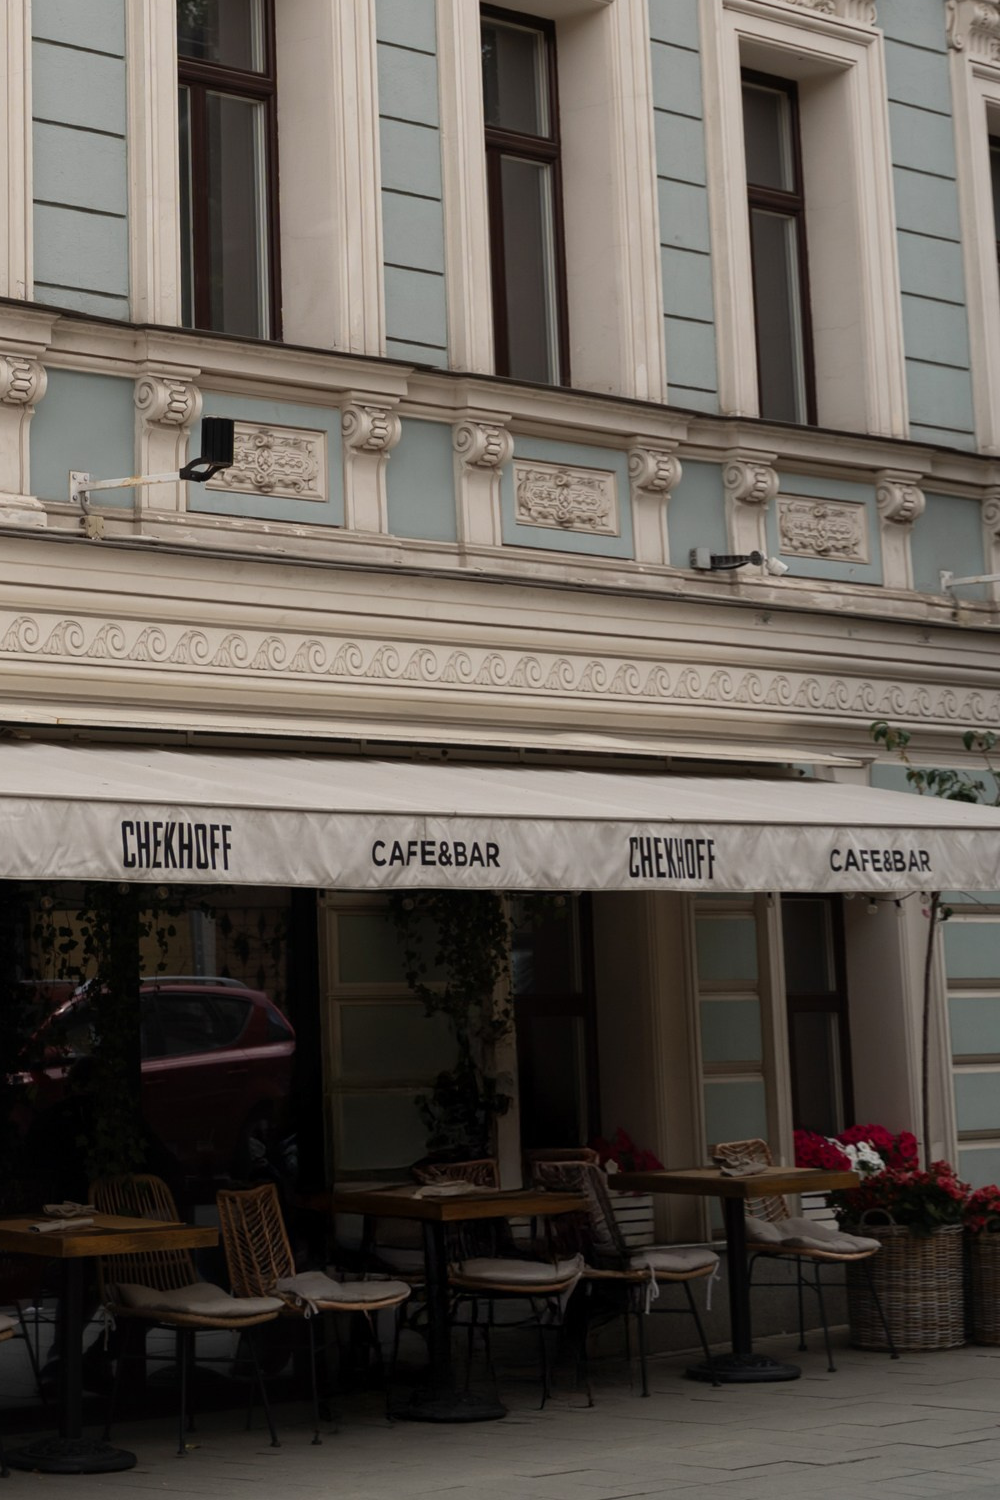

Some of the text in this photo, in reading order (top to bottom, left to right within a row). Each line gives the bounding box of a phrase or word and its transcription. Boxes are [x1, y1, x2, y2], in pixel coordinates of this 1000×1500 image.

[121, 820, 232, 871] CHEKHOFF
[371, 840, 501, 868] CAFE&BAR
[628, 836, 716, 880] CHEKHOFF
[829, 848, 932, 873] CAFE&BAR
